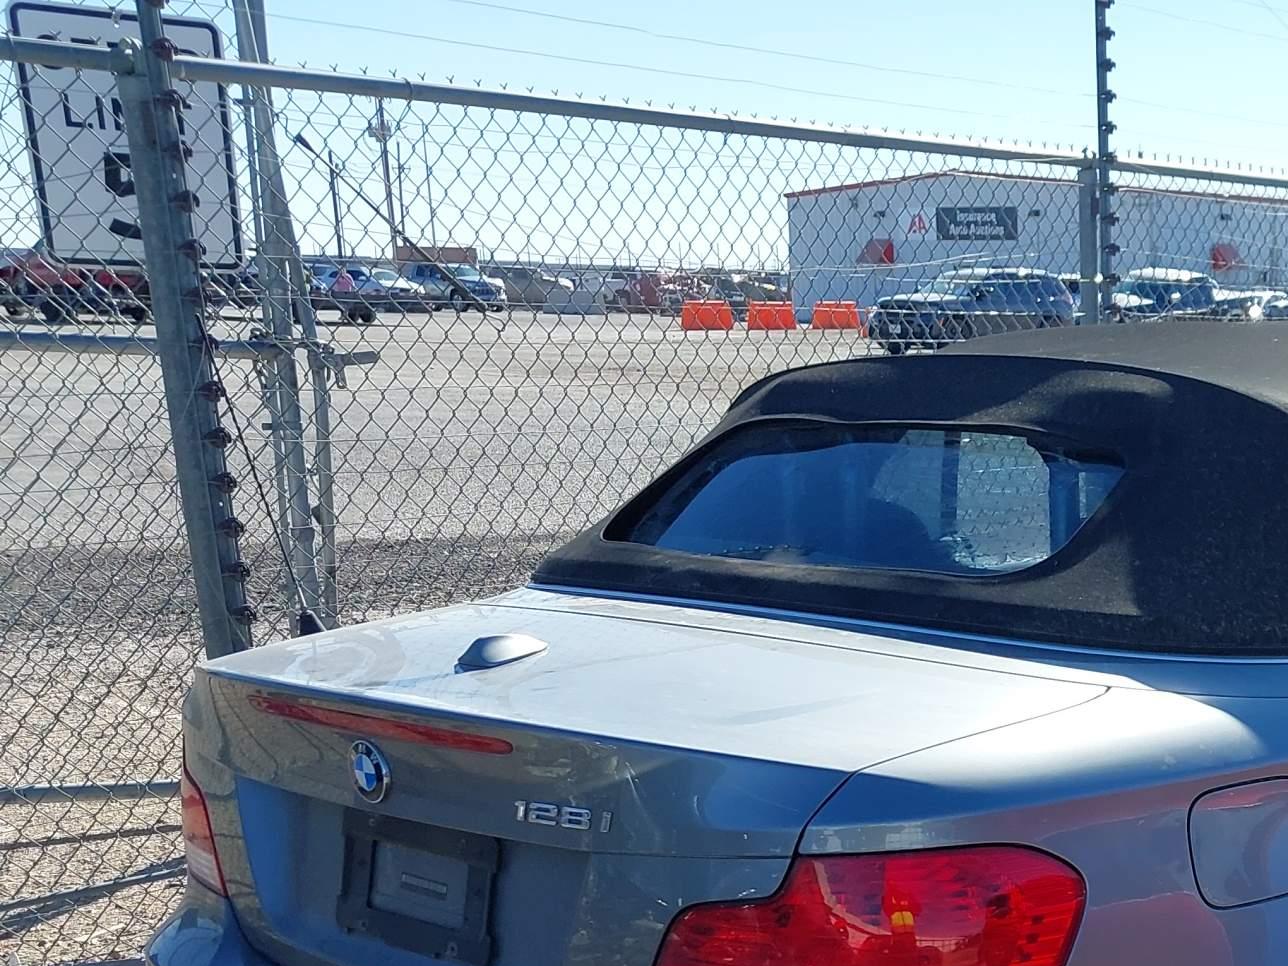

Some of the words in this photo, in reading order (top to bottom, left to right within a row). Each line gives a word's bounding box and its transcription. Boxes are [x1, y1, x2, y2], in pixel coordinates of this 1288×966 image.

[956, 211, 998, 224] Insurance
[949, 223, 968, 236] Auto
[970, 223, 1005, 236] Auctions
